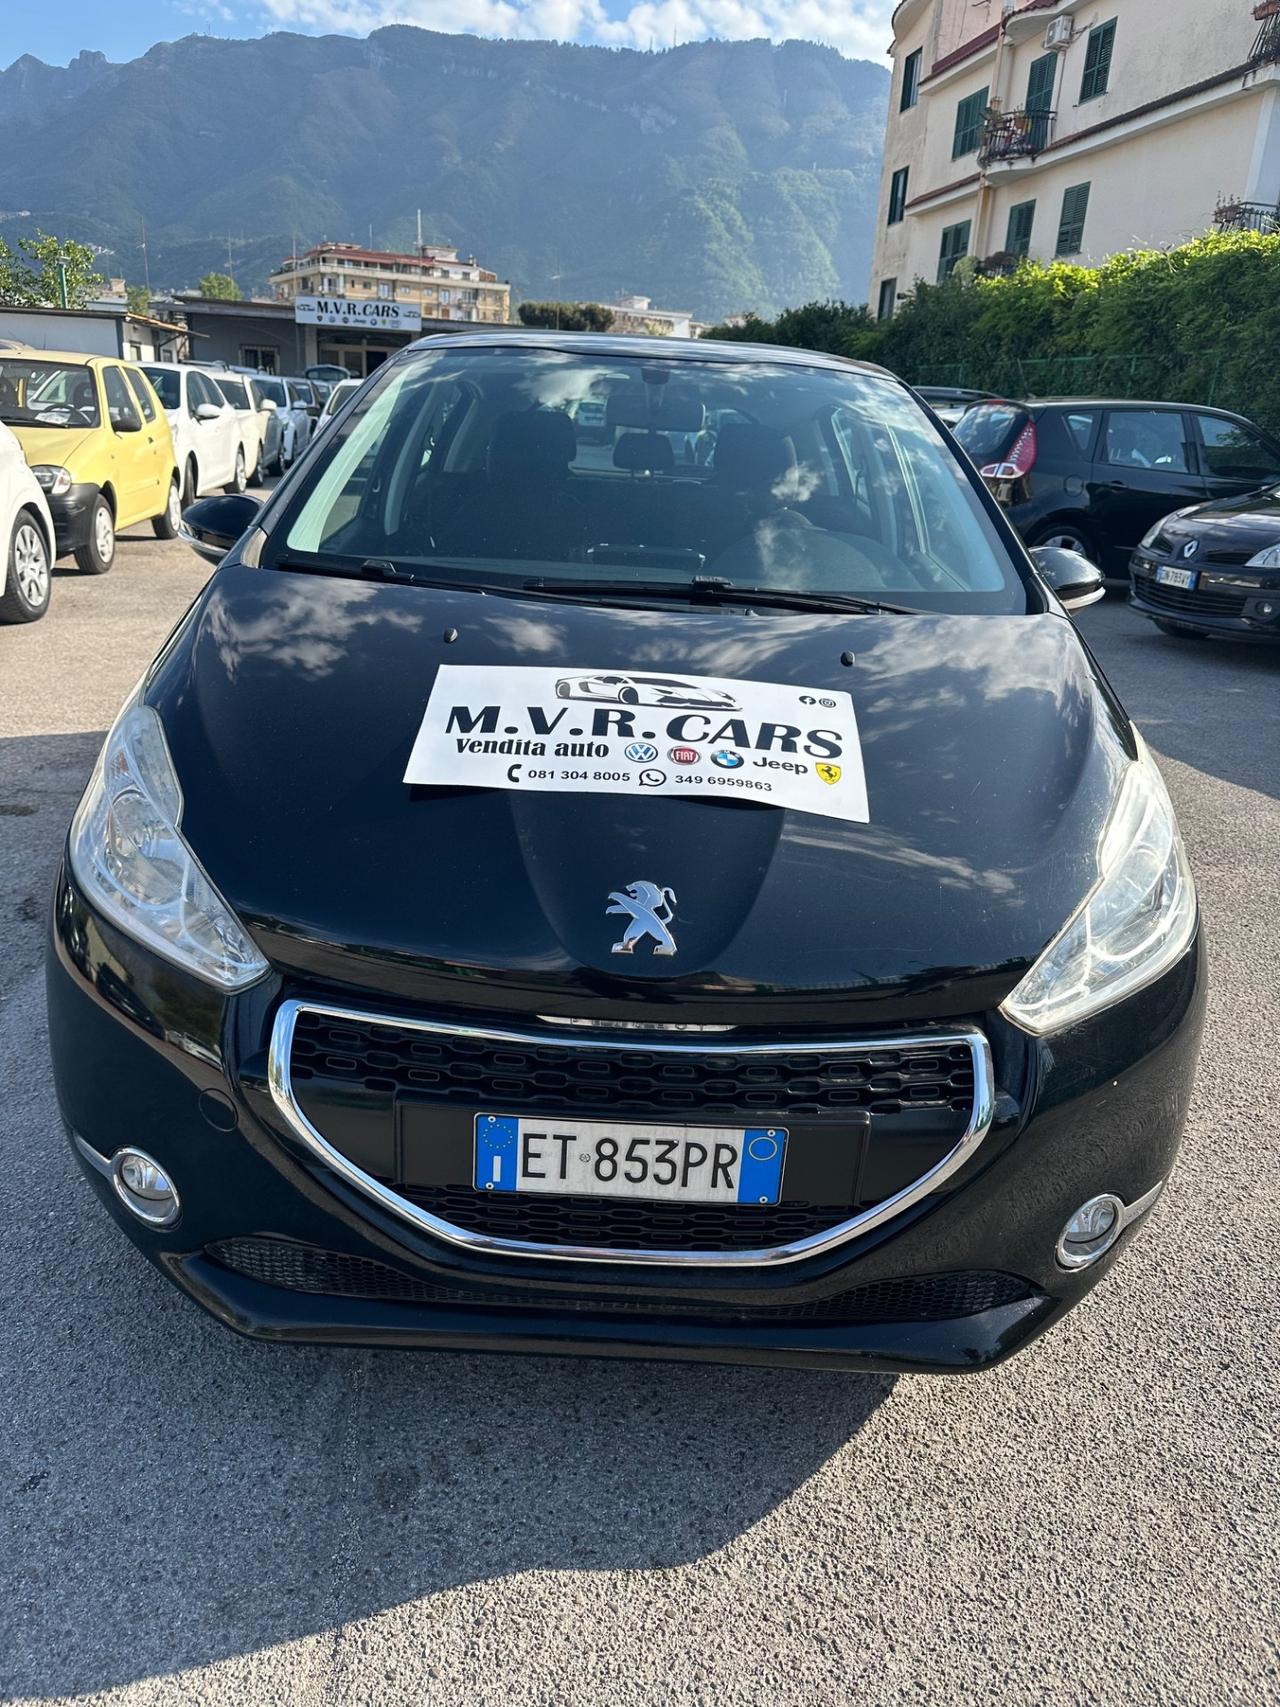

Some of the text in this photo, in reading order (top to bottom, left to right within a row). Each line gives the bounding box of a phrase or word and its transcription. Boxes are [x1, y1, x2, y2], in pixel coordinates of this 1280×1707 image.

[363, 304, 399, 318] CARS
[666, 714, 842, 759] CARS
[456, 738, 609, 757] Vendita auto
[675, 751, 695, 761] FIAT
[753, 757, 808, 775] Jeep
[528, 769, 631, 782] 081 304 8005
[675, 775, 772, 791] 349 6959863
[521, 1133, 738, 1189] ET 853PR
